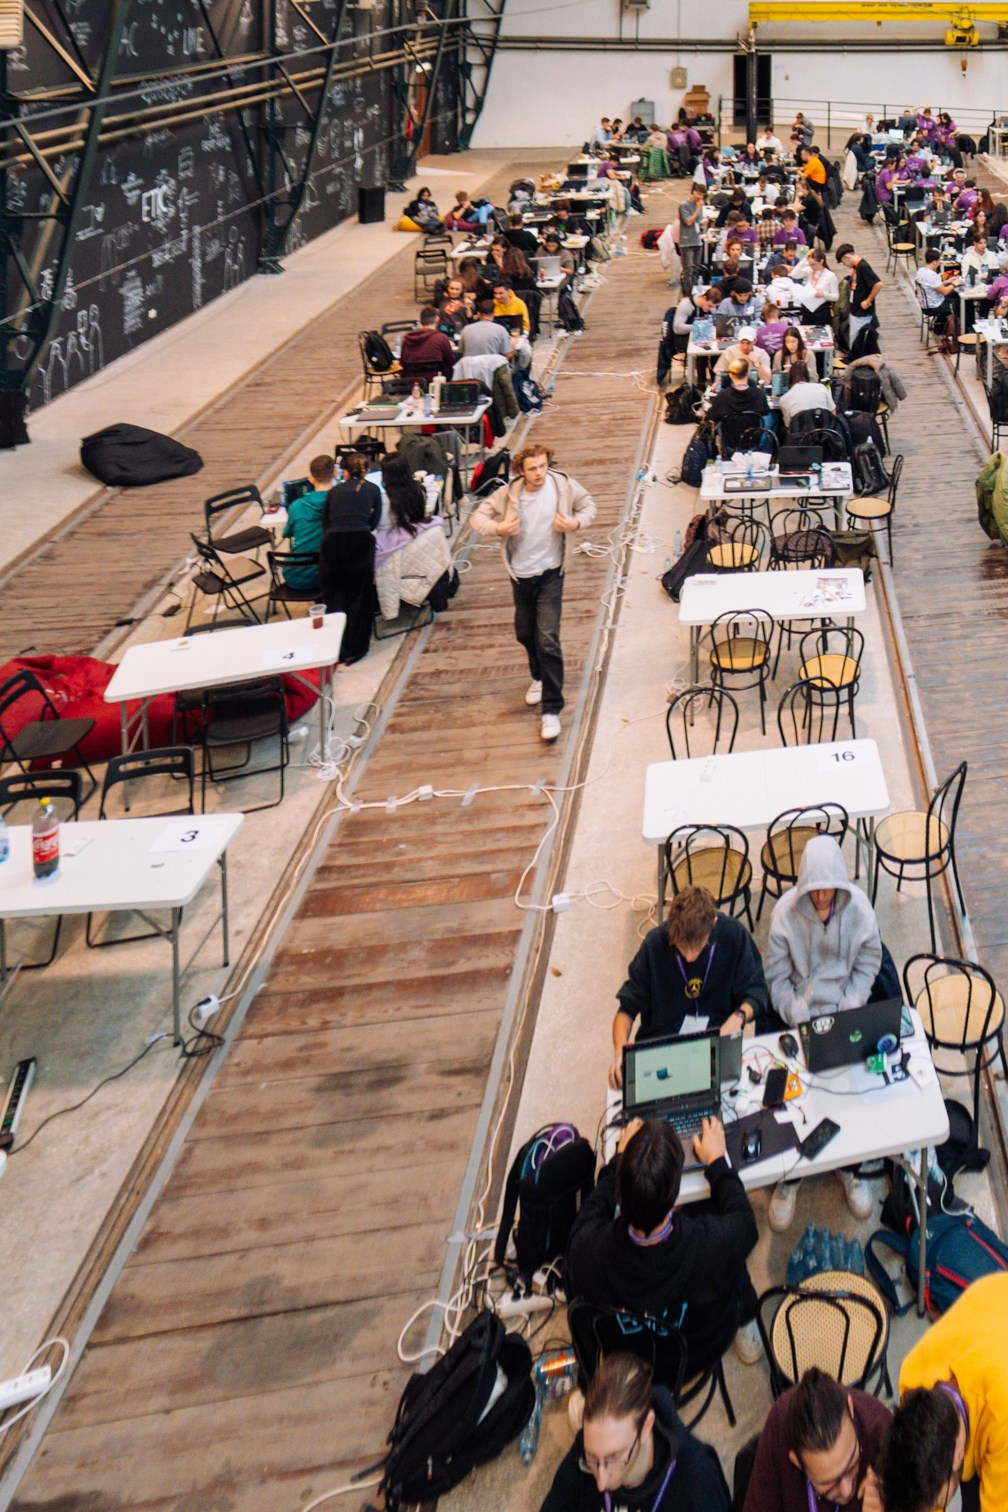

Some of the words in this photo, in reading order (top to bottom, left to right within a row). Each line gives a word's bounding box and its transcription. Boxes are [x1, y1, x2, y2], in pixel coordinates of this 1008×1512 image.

[281, 651, 295, 660] 4
[832, 751, 855, 762] 16
[180, 830, 199, 843] 3
